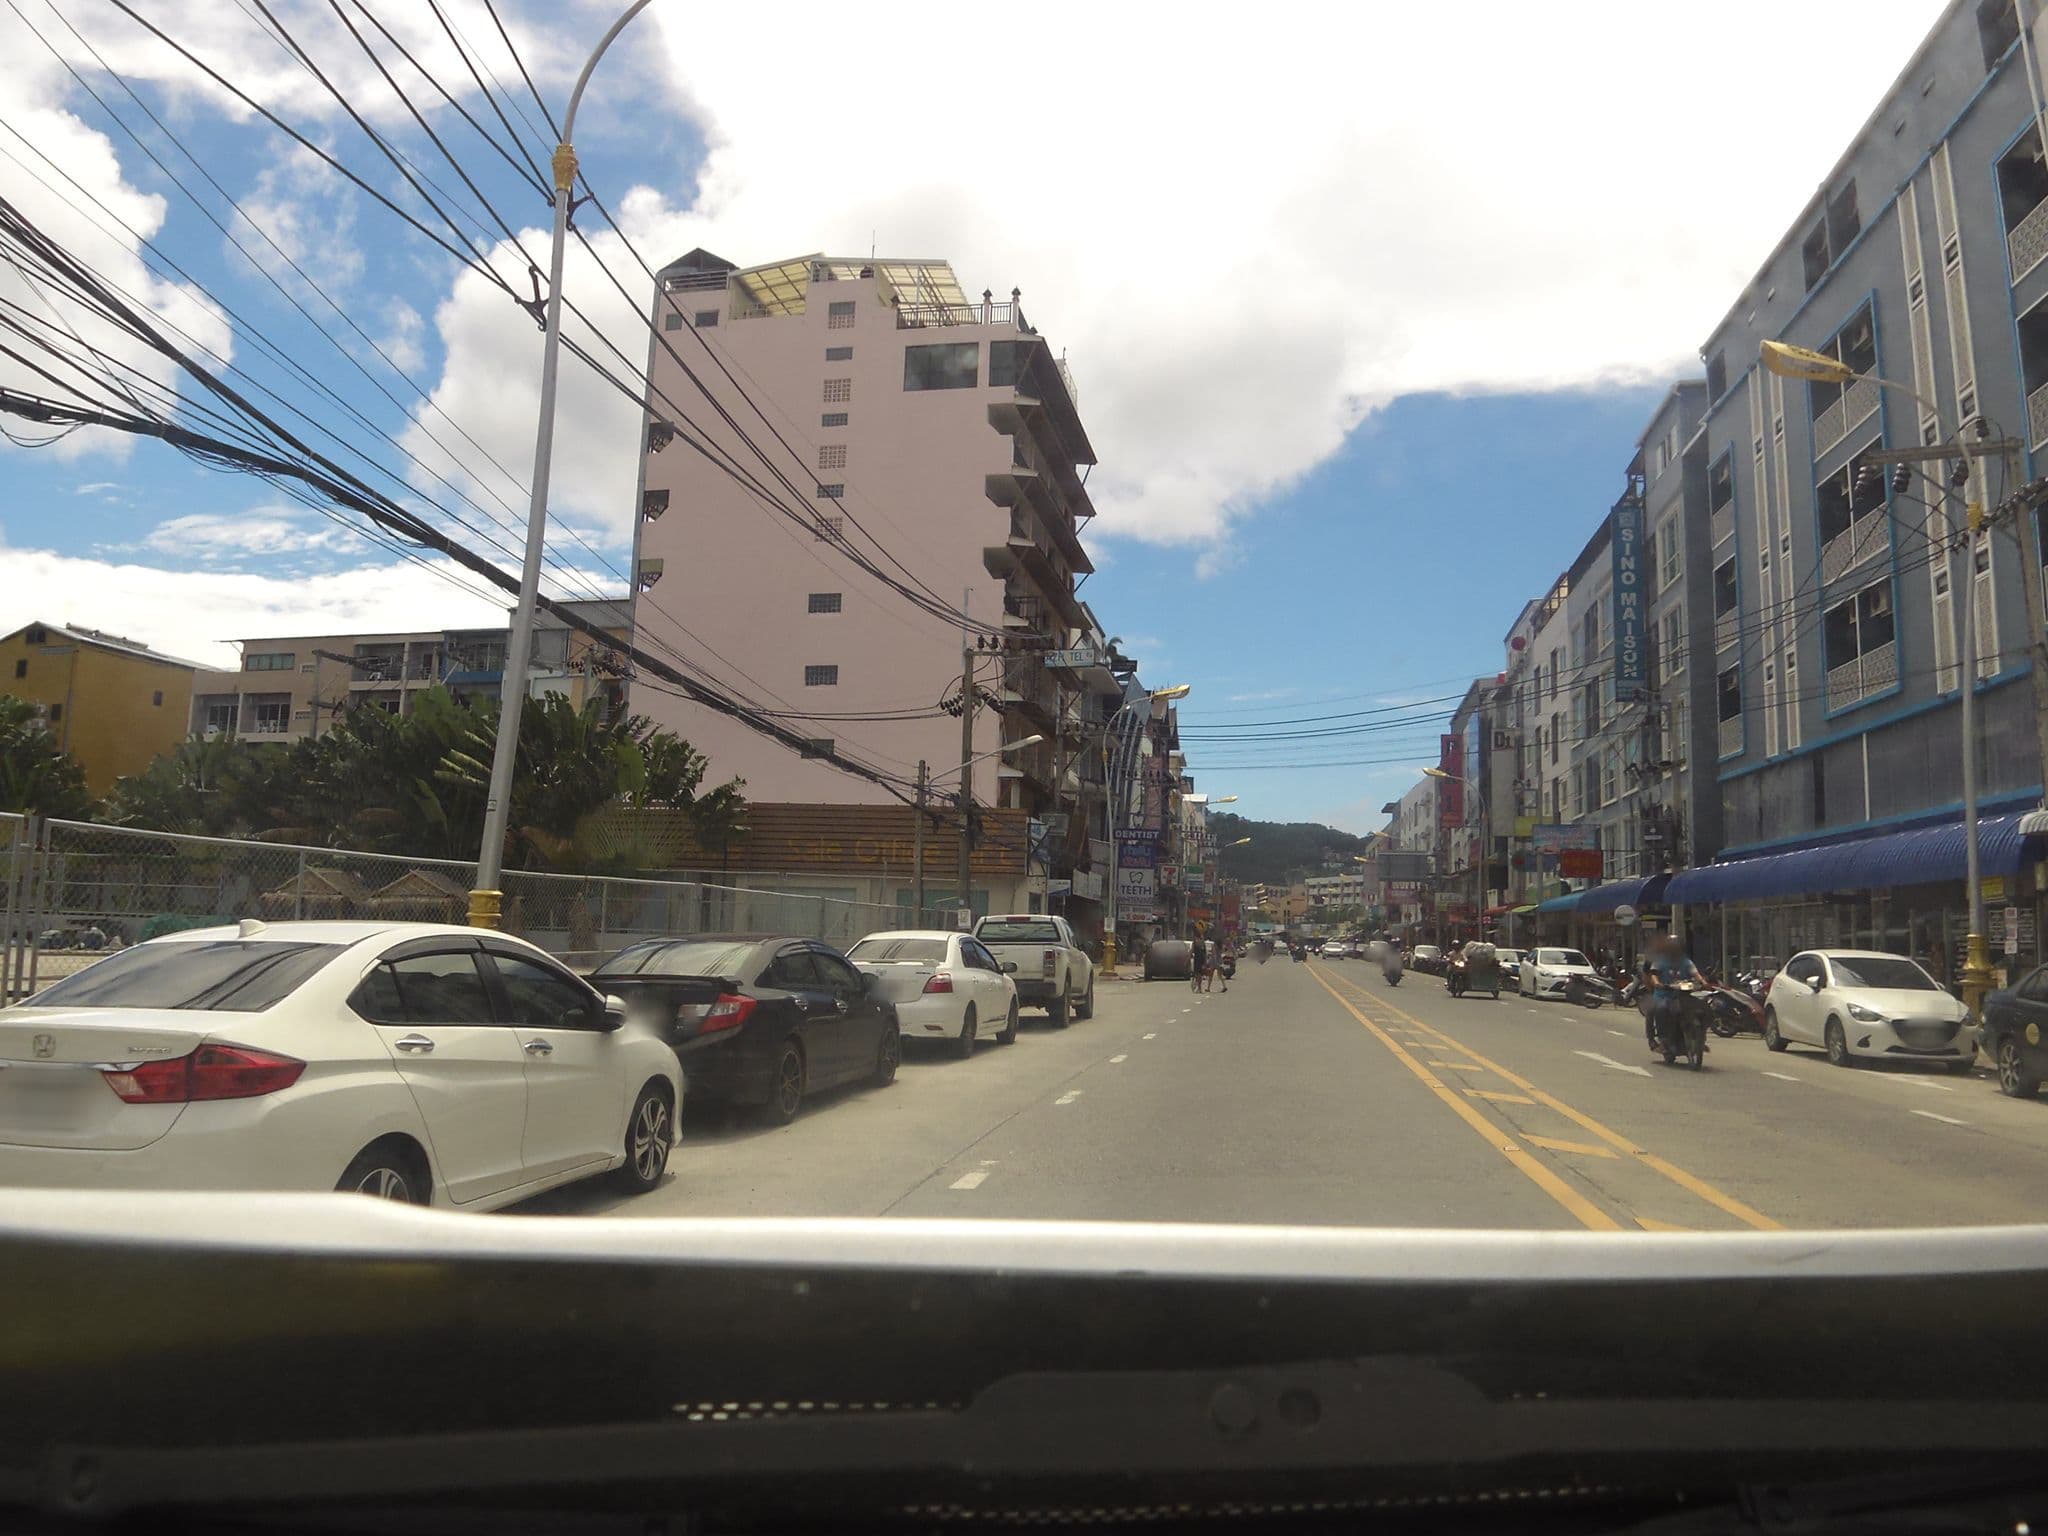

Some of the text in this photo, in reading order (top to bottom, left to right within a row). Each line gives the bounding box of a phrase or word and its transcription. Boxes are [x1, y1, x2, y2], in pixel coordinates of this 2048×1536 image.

[1620, 529, 1636, 585] SINO
[1115, 830, 1159, 839] DENTIST
[1120, 885, 1152, 895] TEETH
